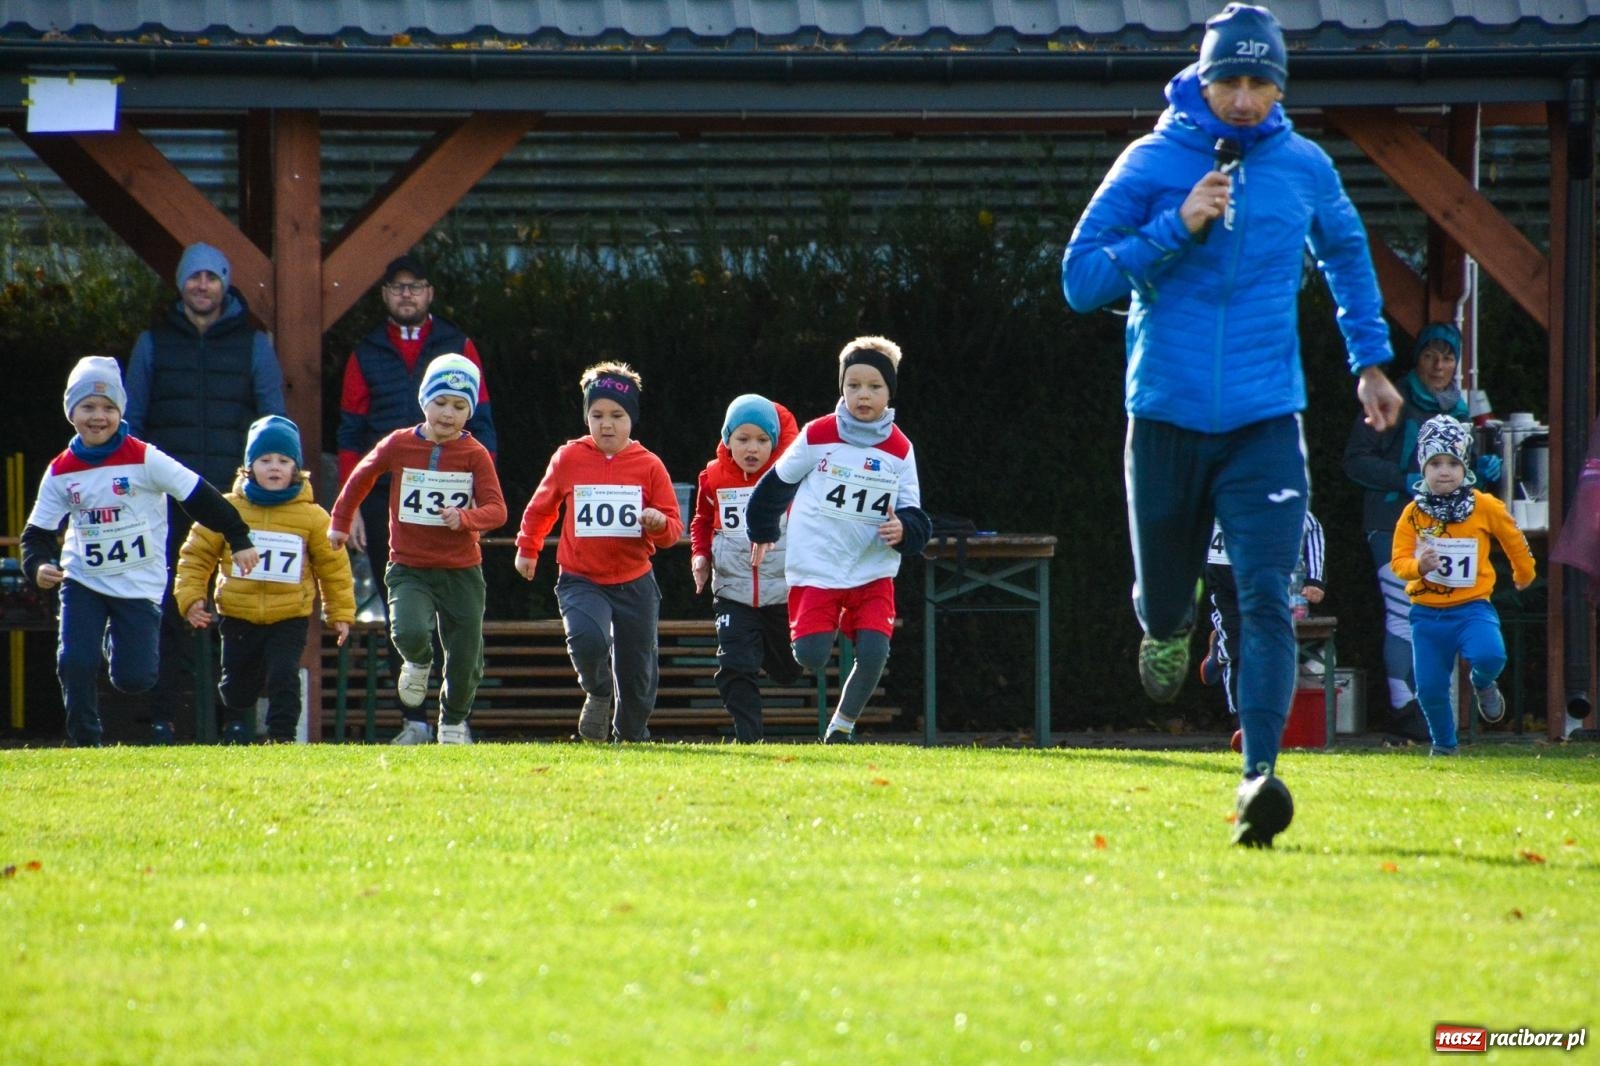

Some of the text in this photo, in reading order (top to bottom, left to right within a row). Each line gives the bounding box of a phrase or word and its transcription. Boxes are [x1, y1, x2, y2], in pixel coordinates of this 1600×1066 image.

[403, 489, 469, 516] 432
[826, 484, 891, 516] 414
[577, 503, 637, 527] 406
[85, 535, 147, 567] 541
[259, 549, 297, 573] 17
[1438, 555, 1470, 578] 31
